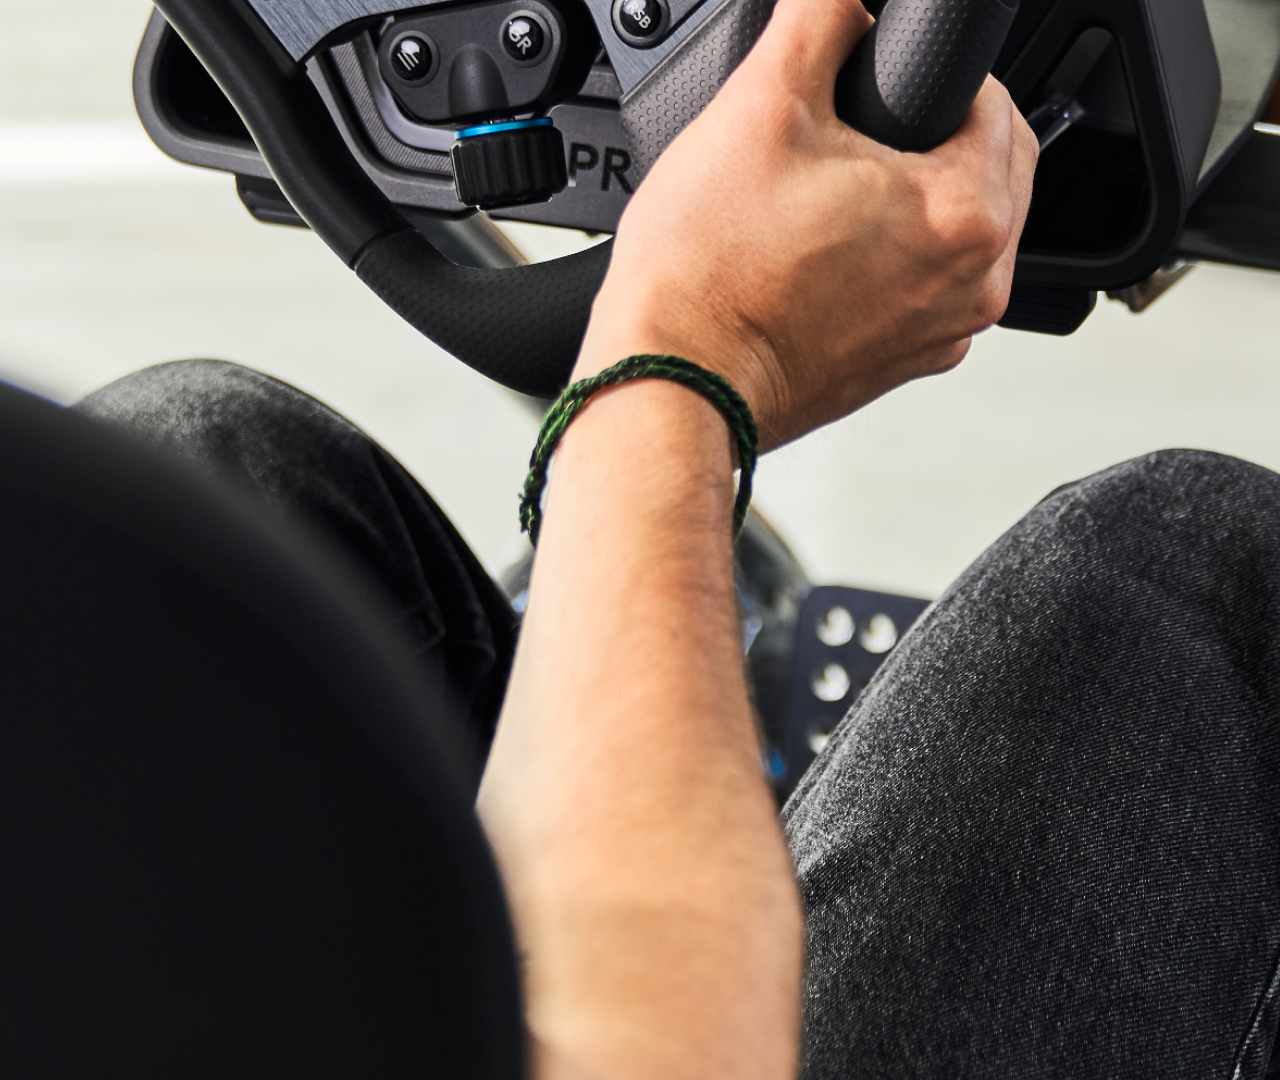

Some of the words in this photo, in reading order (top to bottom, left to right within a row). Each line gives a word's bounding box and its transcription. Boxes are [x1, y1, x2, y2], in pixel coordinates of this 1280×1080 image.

[626, 0, 651, 29] RSB
[509, 26, 532, 55] GR
[568, 142, 634, 194] PR
